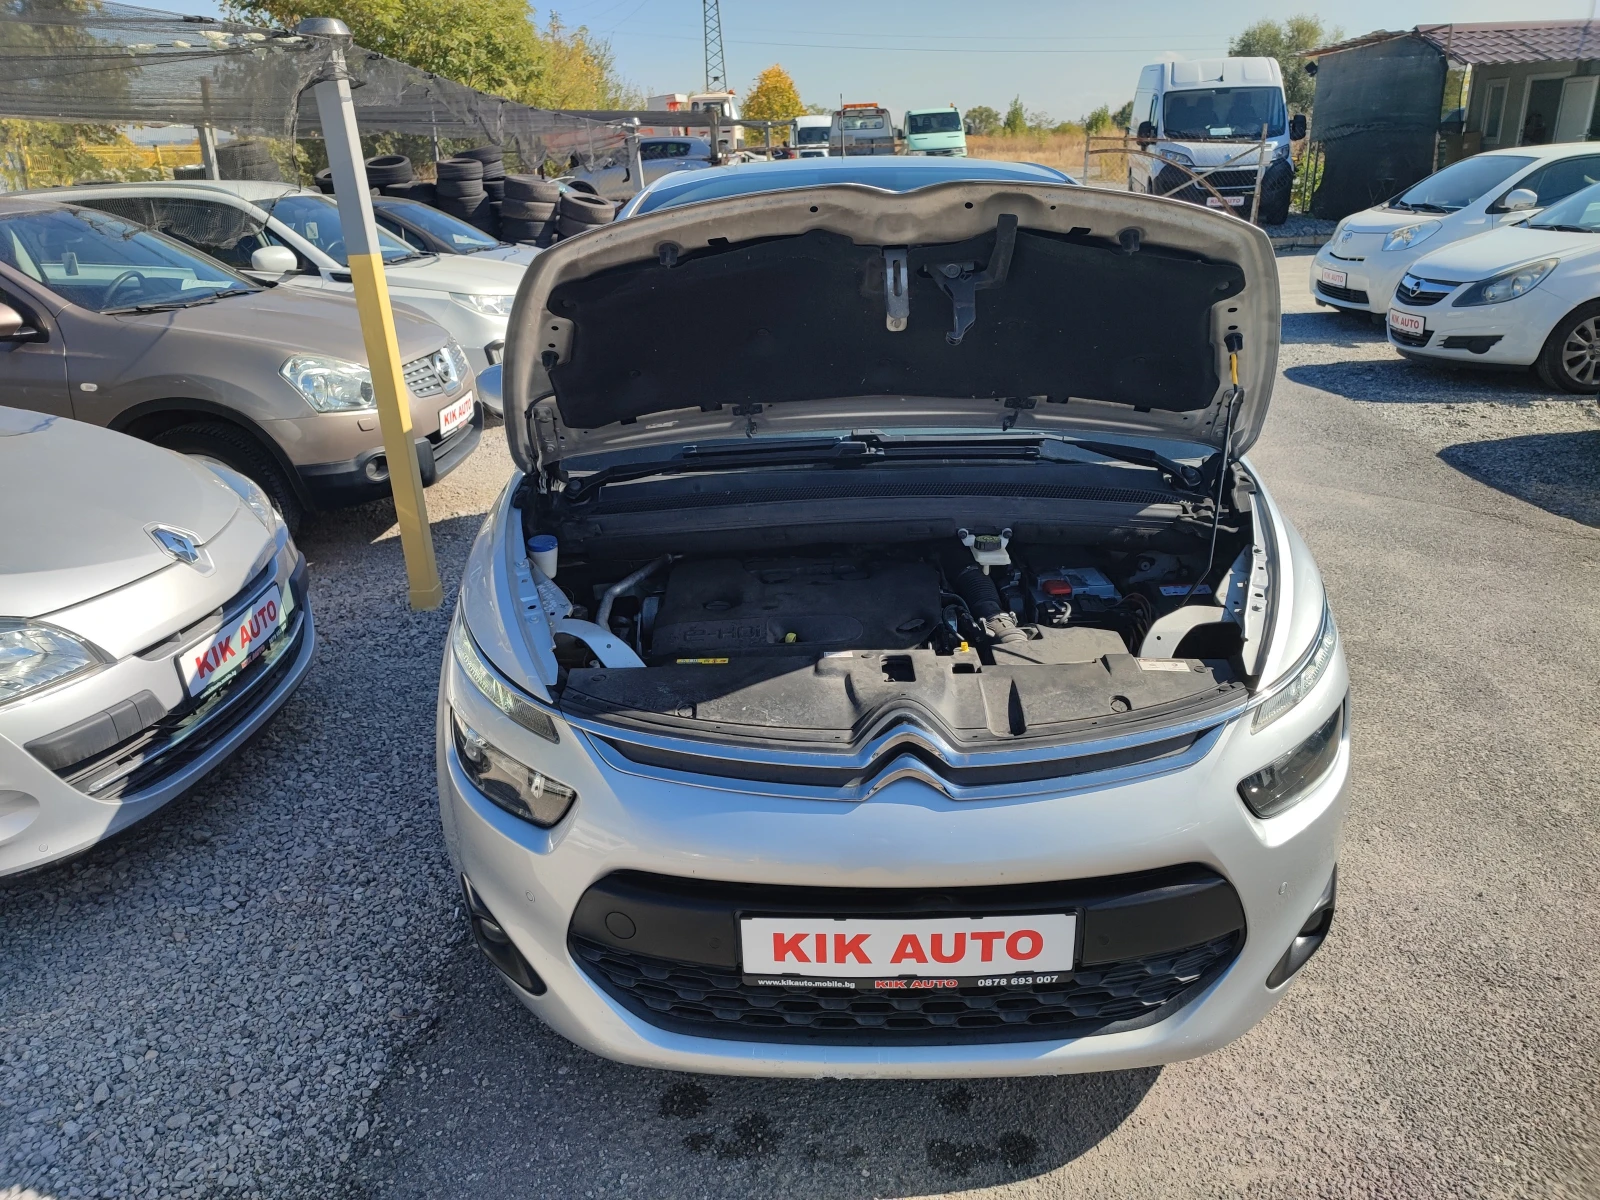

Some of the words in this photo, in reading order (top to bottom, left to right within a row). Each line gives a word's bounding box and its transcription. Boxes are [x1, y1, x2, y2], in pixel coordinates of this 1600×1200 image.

[1400, 317, 1420, 329] AUTO
[444, 408, 457, 426] KIK
[458, 398, 472, 418] AUTO
[195, 635, 236, 679] KIK
[239, 600, 277, 649] AUTO
[773, 932, 873, 965] KIK
[890, 929, 1044, 964] AUTO
[758, 978, 856, 989] www.kikauto.mobile.bg
[875, 979, 906, 989] KIK
[910, 979, 959, 989] AUTO
[977, 978, 1007, 987] 0878
[1010, 977, 1033, 986] 693
[1036, 975, 1059, 985] 007
